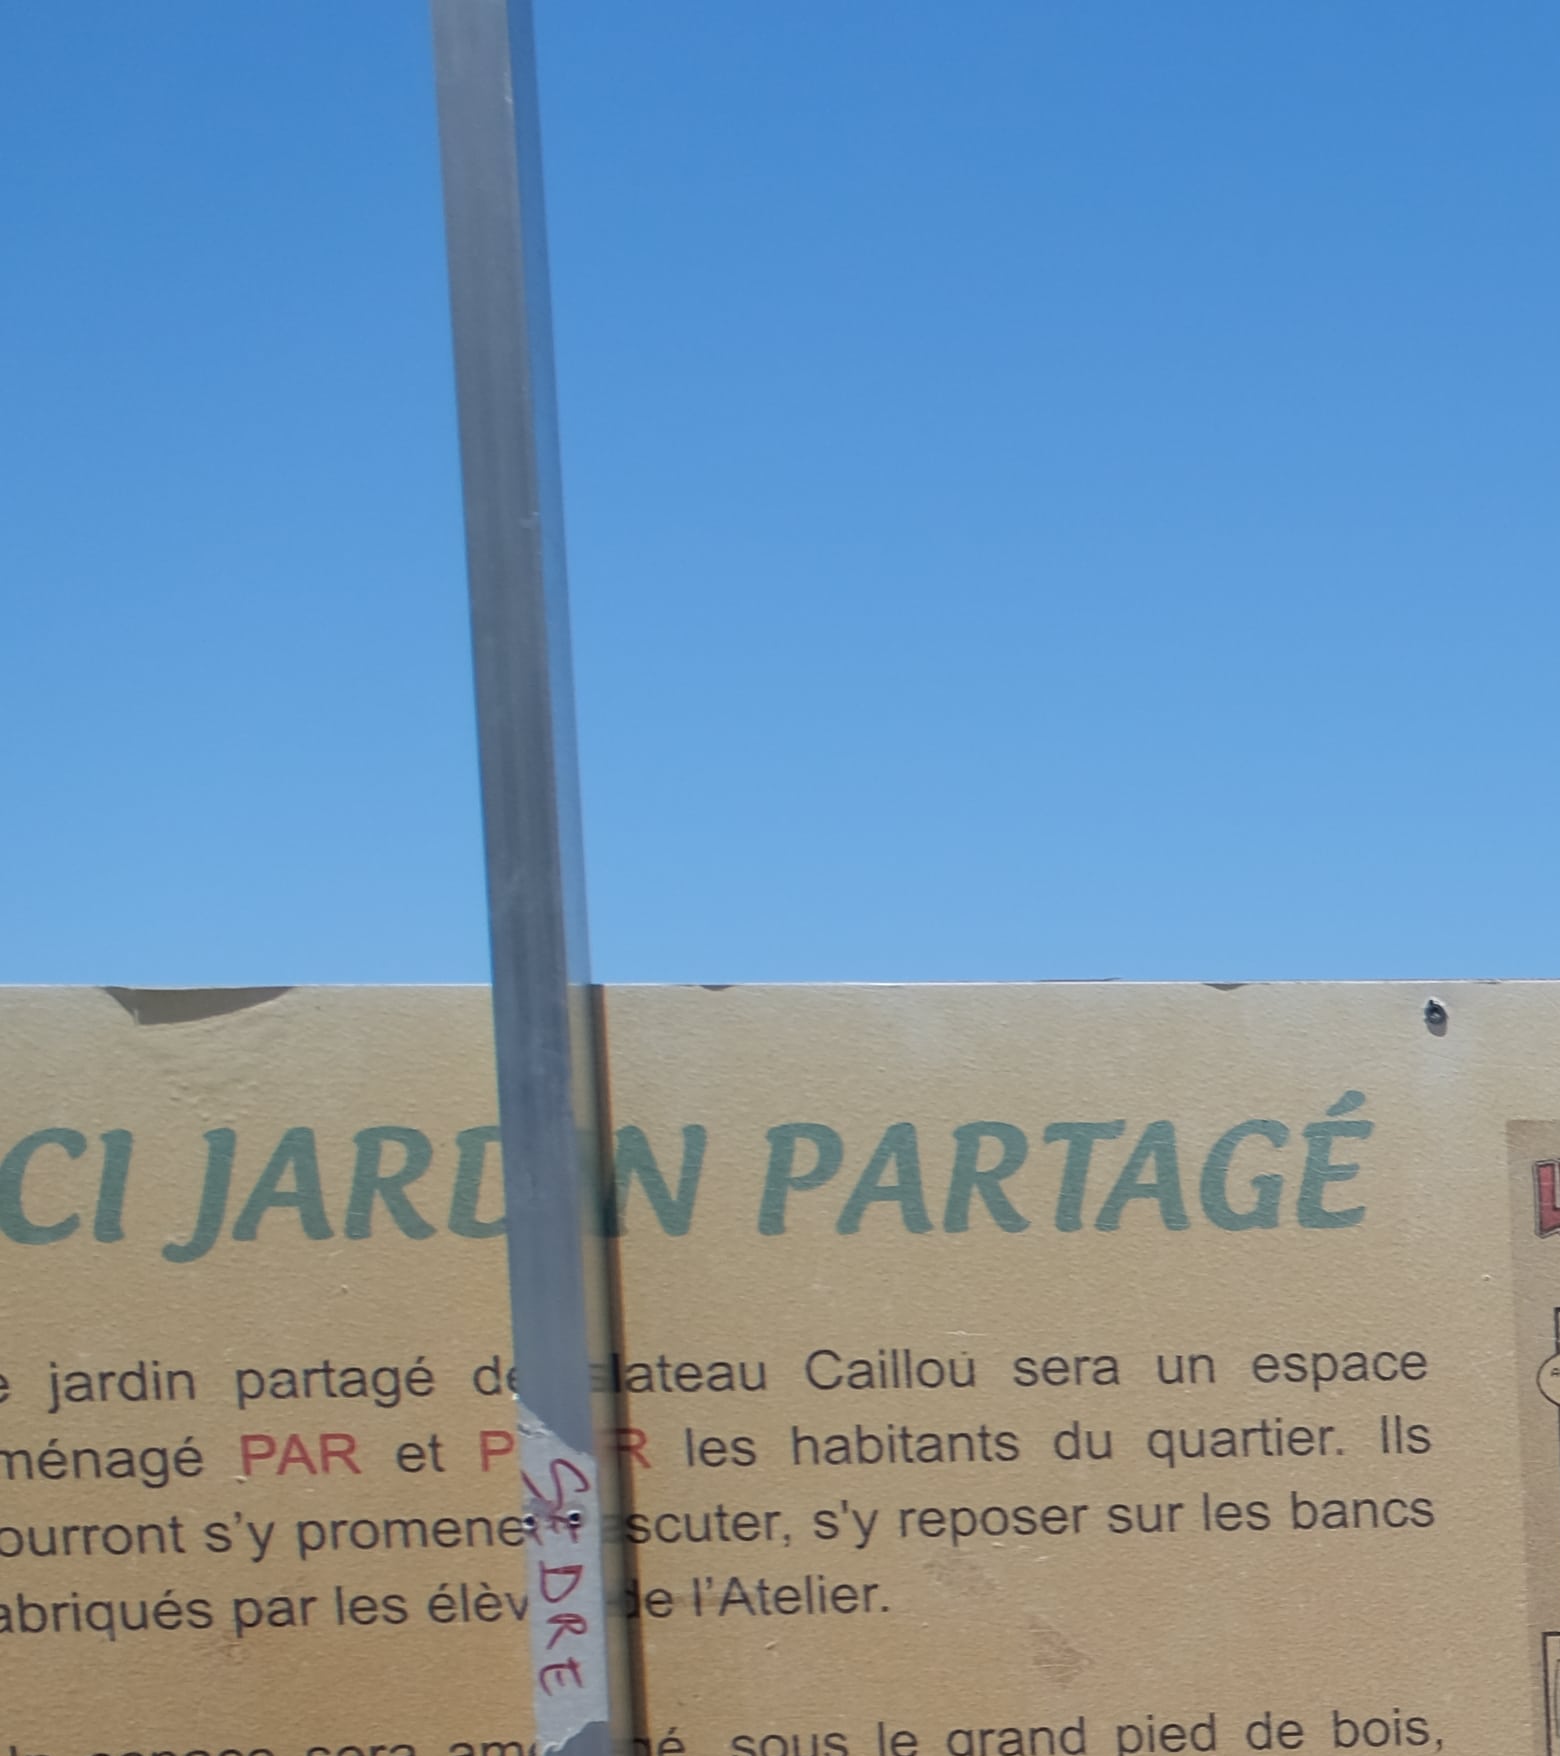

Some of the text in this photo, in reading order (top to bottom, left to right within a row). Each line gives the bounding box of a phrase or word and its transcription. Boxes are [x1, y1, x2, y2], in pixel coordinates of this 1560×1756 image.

[0, 1091, 1374, 1263] CI JARDN PARTAGÉ
[48, 1349, 1428, 1414] jardin partagé Caillou sera un espace
[240, 1415, 1432, 1476] PAR et les habitants du quartier. Ils
[0, 1516, 186, 1557] ourront
[899, 1505, 1089, 1547] reposer
[1107, 1503, 1184, 1534] sur
[1203, 1492, 1271, 1531] les
[1290, 1491, 1435, 1530] bancs
[0, 1589, 214, 1642] abriqués
[233, 1596, 318, 1639] par
[335, 1586, 409, 1625] les
[1246, 1711, 1304, 1750] de
[1332, 1708, 1443, 1752] bois,
